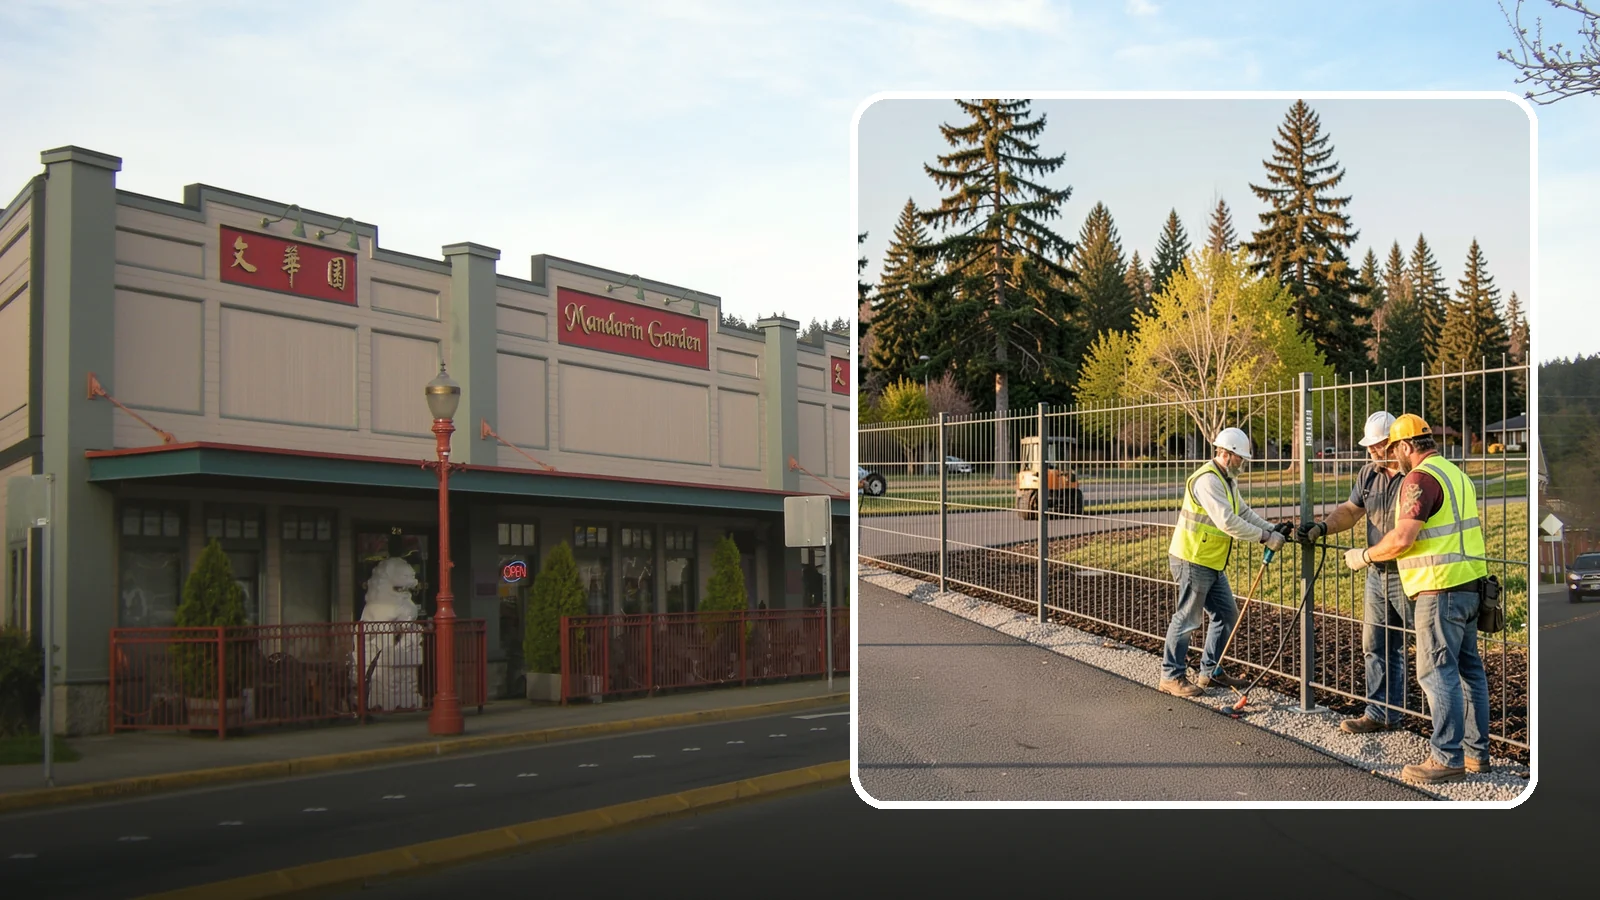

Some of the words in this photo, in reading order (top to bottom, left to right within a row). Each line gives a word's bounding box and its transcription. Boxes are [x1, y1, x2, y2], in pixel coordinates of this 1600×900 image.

[564, 302, 644, 341] Mandarin
[647, 320, 701, 352] Garden
[503, 565, 527, 578] OPEN
